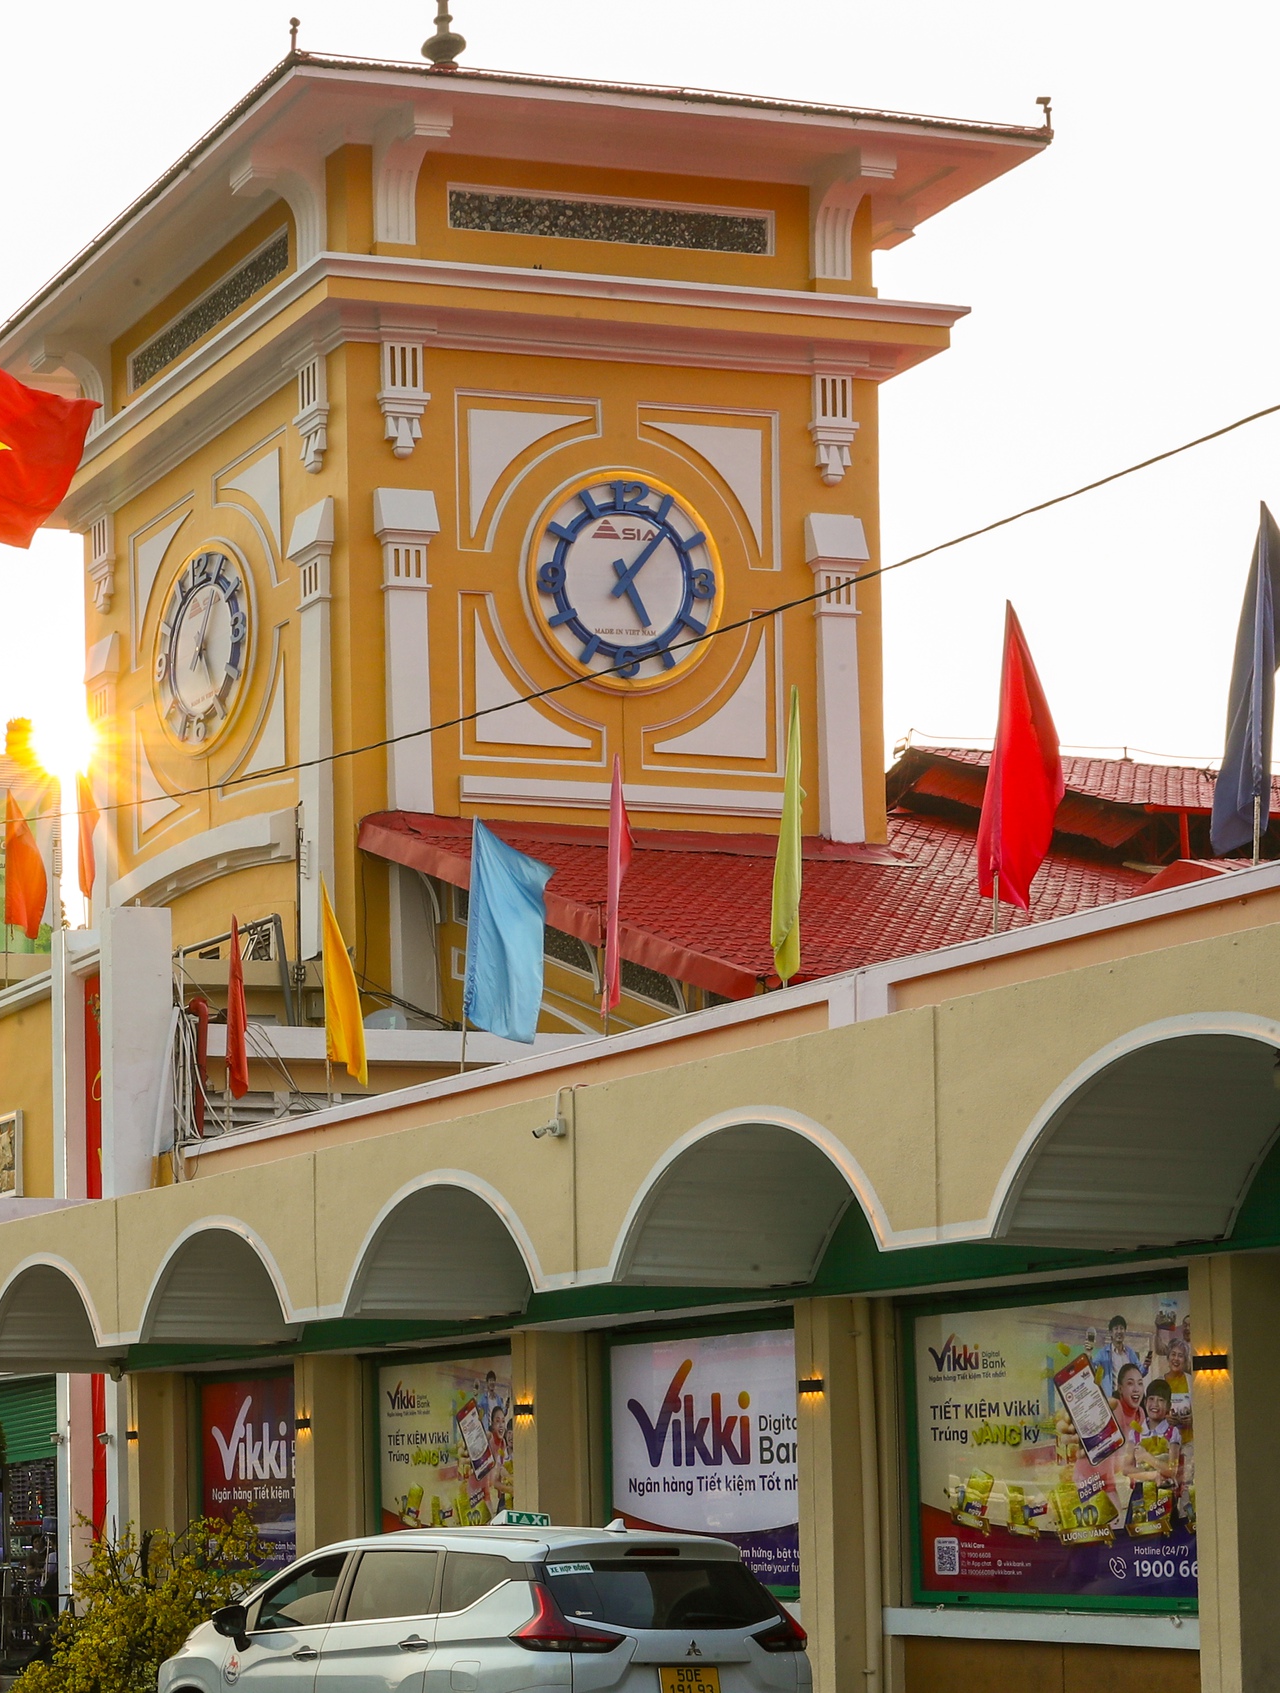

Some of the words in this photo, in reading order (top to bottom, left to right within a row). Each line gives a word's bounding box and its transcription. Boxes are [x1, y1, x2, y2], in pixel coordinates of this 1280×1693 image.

[610, 480, 650, 511] 12
[188, 554, 208, 588] 12
[537, 561, 566, 594] 9
[691, 568, 716, 599] 3
[230, 611, 246, 643] 3
[641, 628, 657, 637] NAM
[155, 653, 168, 682] 9
[614, 647, 640, 677] 6
[192, 714, 207, 742] 6
[928, 1332, 979, 1372] Vikki
[982, 1358, 1006, 1369] Bank
[386, 1380, 416, 1410] Vikki
[627, 1359, 751, 1468] Vikki
[930, 1398, 961, 1420] TIẾT
[965, 1399, 1000, 1422] KIỆM
[1003, 1399, 1040, 1417] Vikki
[758, 1414, 797, 1435] Digita
[930, 1426, 968, 1444] Trúng
[972, 1421, 1023, 1446] VÀNG
[1024, 1425, 1040, 1443] ký
[211, 1395, 287, 1480] Vikki
[388, 1429, 405, 1446] TIẾT
[407, 1430, 427, 1448] KIỆM
[429, 1431, 449, 1444] Vikki
[388, 1450, 410, 1464] Trúng
[411, 1447, 439, 1467] VÀNG
[233, 1486, 252, 1502] hàng
[253, 1484, 269, 1499] Tiết
[271, 1486, 290, 1502] kiệm
[629, 1475, 660, 1496] Ngân
[663, 1475, 694, 1496] hàng
[696, 1471, 722, 1492] Tiết
[725, 1474, 756, 1496] kiệm
[758, 1471, 781, 1492] Tốt
[1073, 1504, 1099, 1527] 10
[752, 1546, 775, 1560] hứng,
[777, 1547, 792, 1561] bật
[1134, 1546, 1161, 1555] Hotline
[1162, 1546, 1189, 1556] (24/7)
[750, 1561, 772, 1573] ignite
[773, 1564, 790, 1574] your
[1133, 1560, 1175, 1578] 1900
[677, 1669, 702, 1682] 50E
